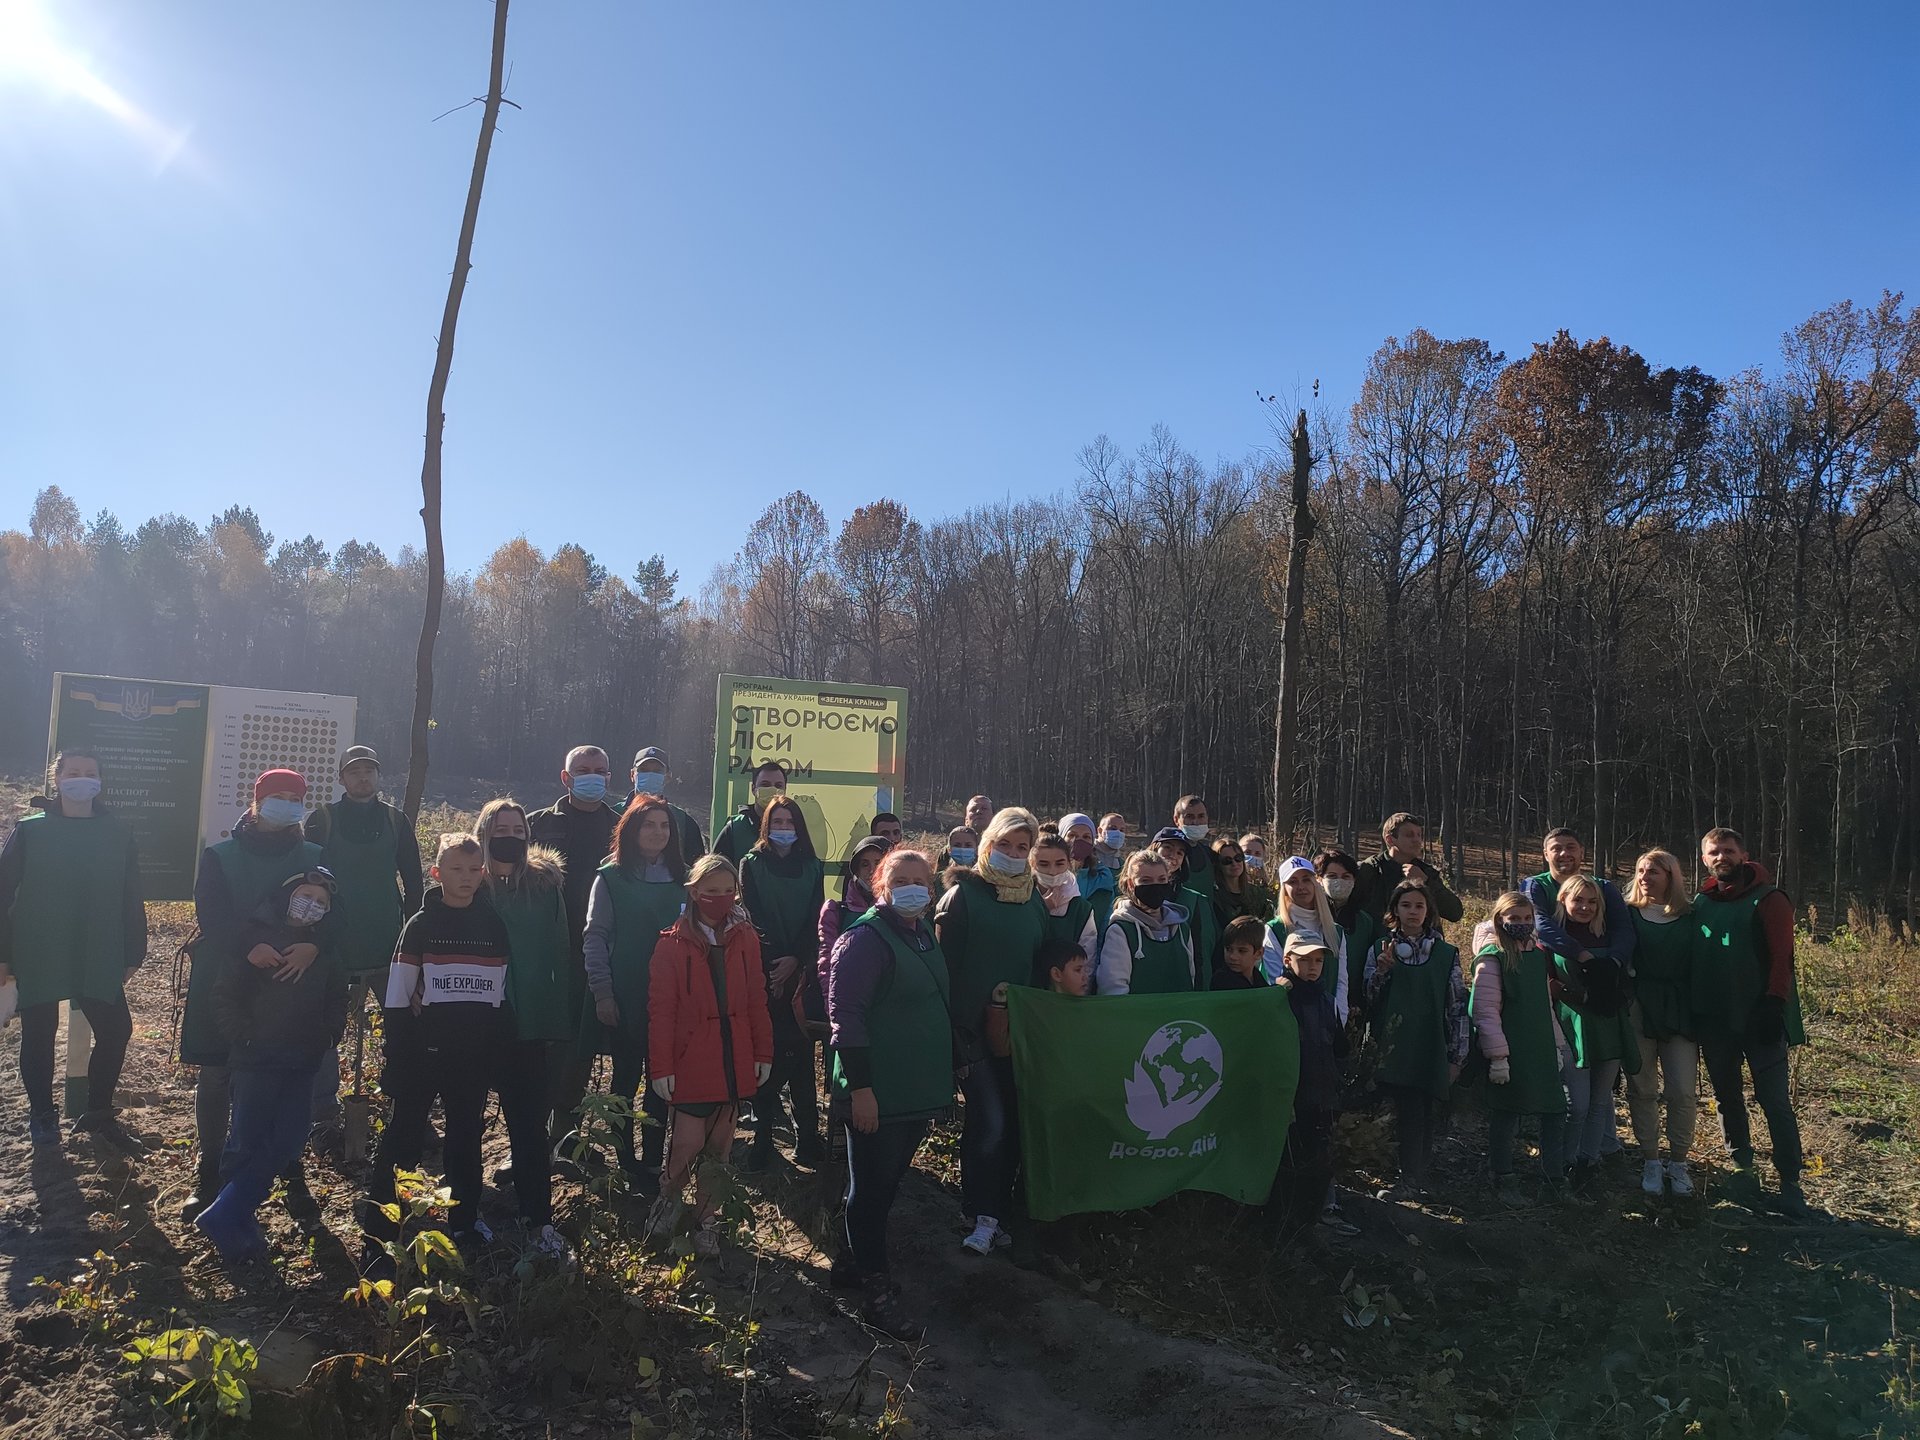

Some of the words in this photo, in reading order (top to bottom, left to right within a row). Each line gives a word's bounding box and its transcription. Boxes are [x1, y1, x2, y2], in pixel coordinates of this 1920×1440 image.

[732, 682, 774, 691] ПРОГРАМА
[732, 689, 783, 700] ПРЕЗИДЕНТА
[783, 693, 815, 703] УКРАЇНИ
[820, 696, 853, 706] «ЗЕЛЕНА
[853, 698, 885, 708] КРАЇНА»
[731, 704, 899, 735] СТВОРЮЄМО
[729, 730, 793, 752] ЛІСИ
[107, 787, 150, 797] ПАСПОРТ
[432, 977, 451, 990] TRUE
[1109, 1140, 1186, 1160] Добро.
